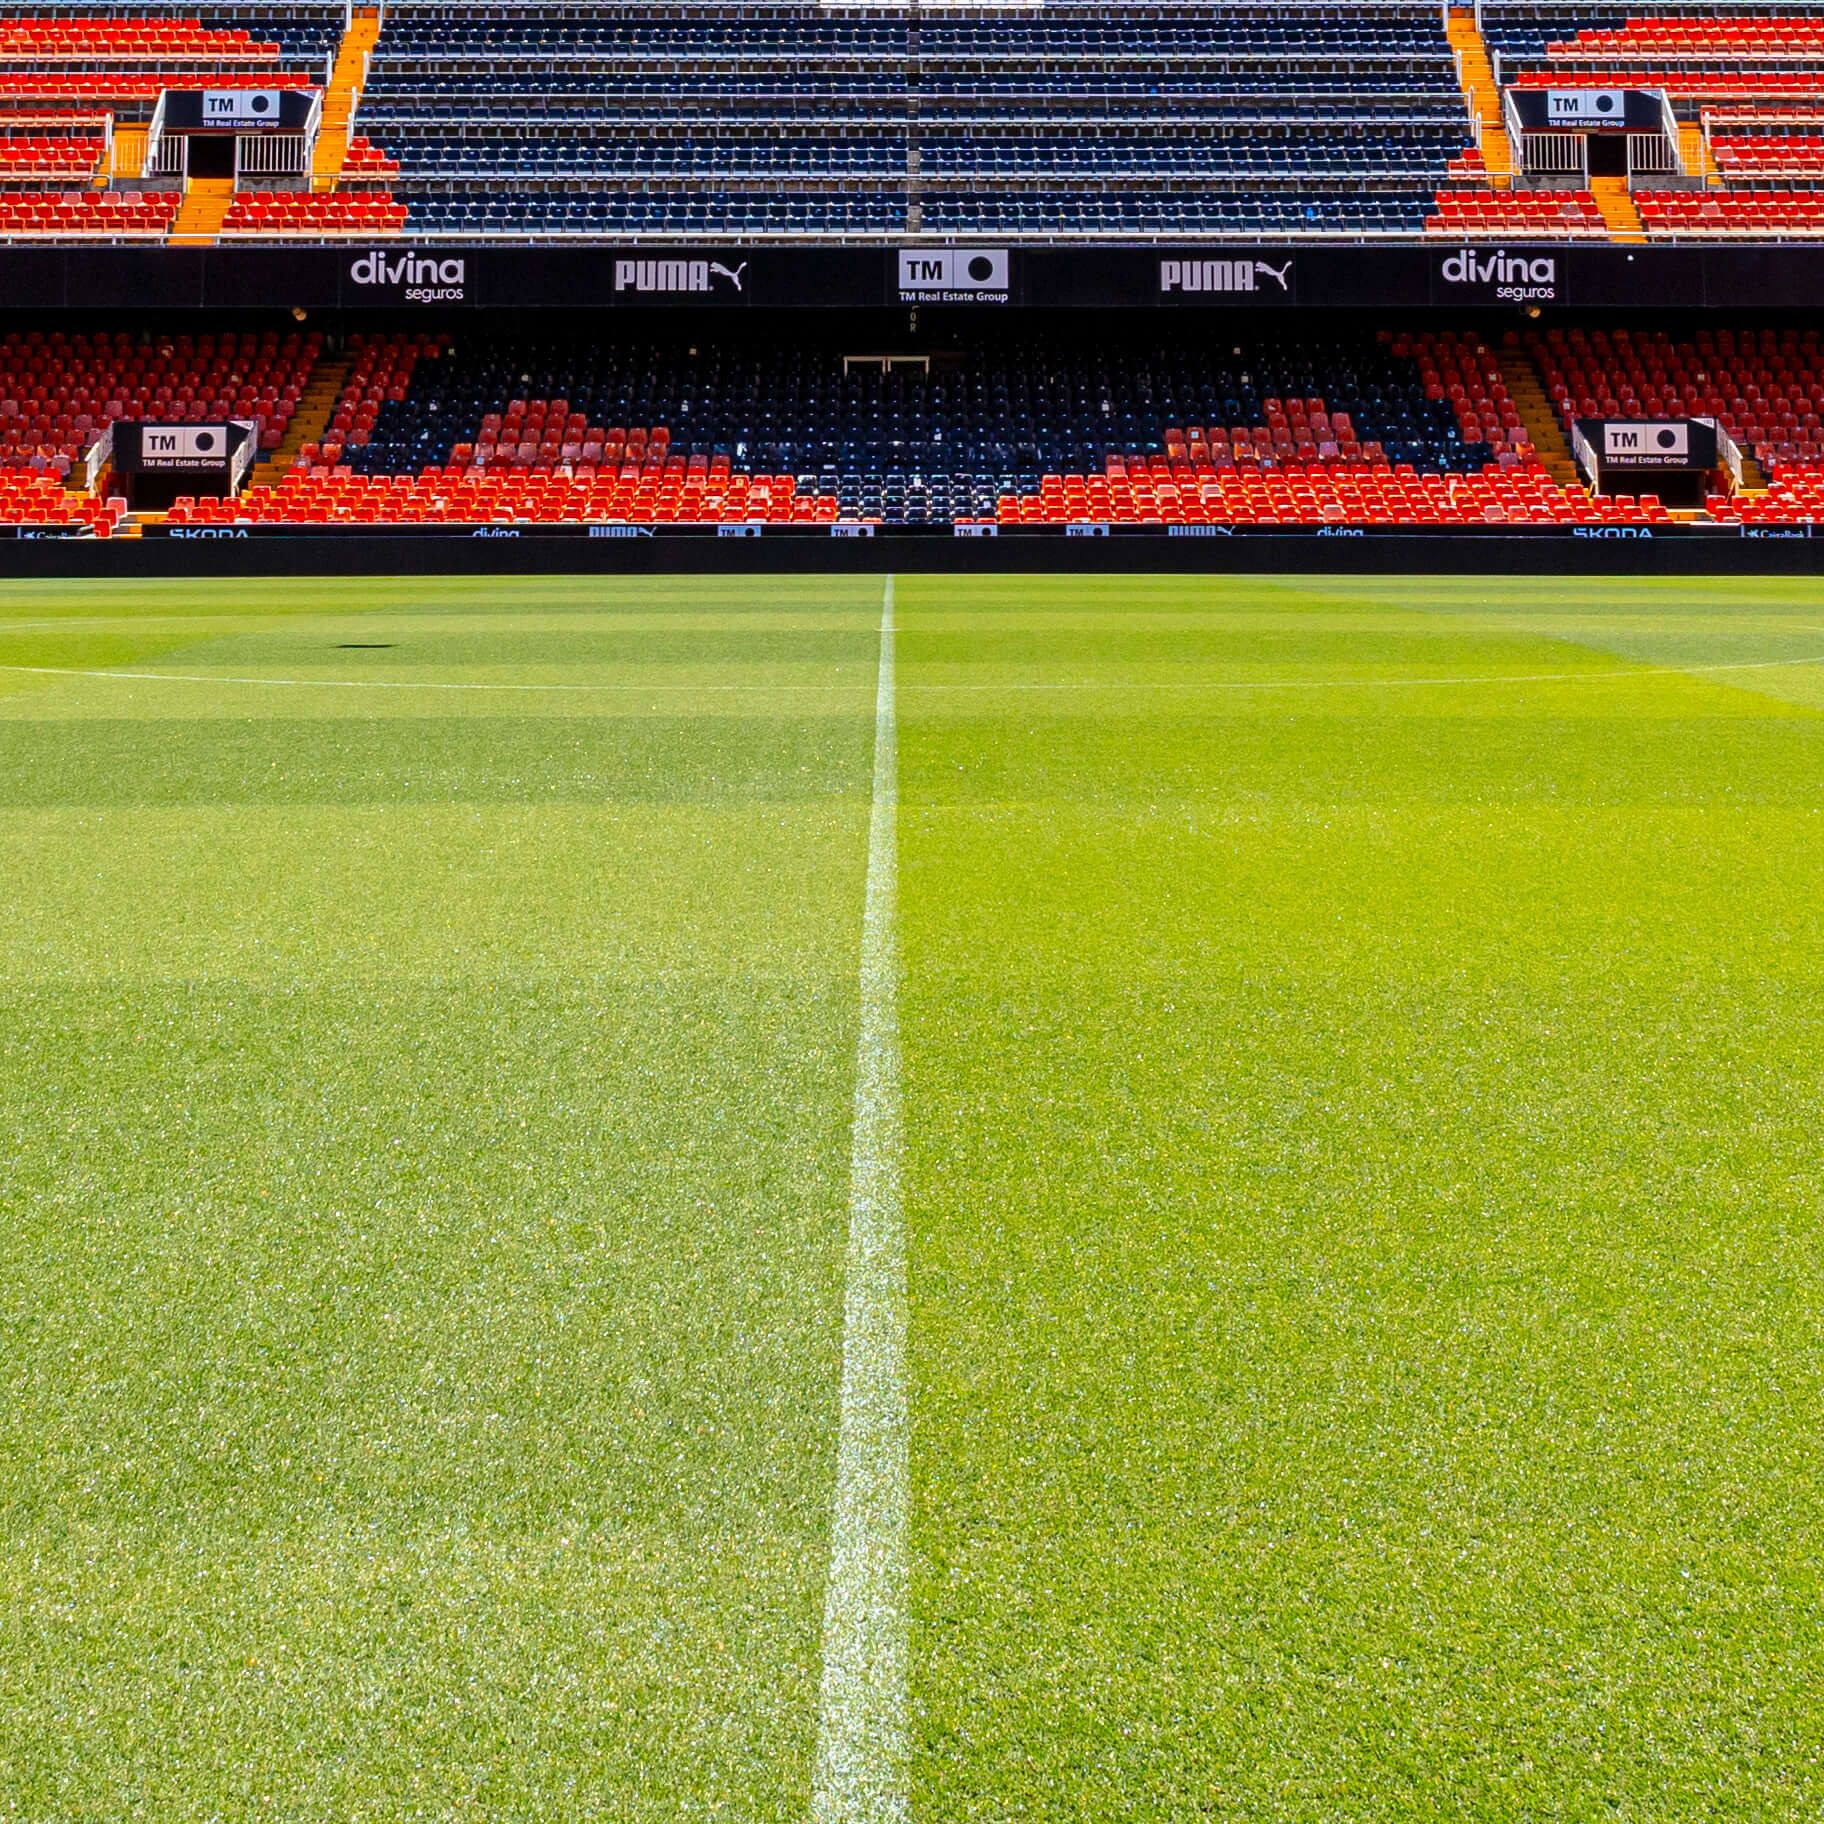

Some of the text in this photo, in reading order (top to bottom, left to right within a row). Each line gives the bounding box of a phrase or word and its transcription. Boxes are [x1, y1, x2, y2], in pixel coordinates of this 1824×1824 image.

[208, 98, 234, 112] TM
[1553, 98, 1578, 112] TM
[350, 251, 465, 284] divina
[906, 260, 943, 281] TM
[1441, 249, 1555, 283] divina
[615, 260, 710, 291] PUMA
[1161, 260, 1255, 291] PUMA
[405, 288, 464, 304] seguros
[898, 292, 1009, 304] TM Real Estate Group
[1496, 286, 1555, 302] seguros
[149, 435, 176, 450] TM
[1610, 432, 1637, 447] TM
[720, 529, 735, 537] TM
[834, 529, 848, 537] TM
[958, 529, 971, 537] TM
[1069, 529, 1083, 537] TM
